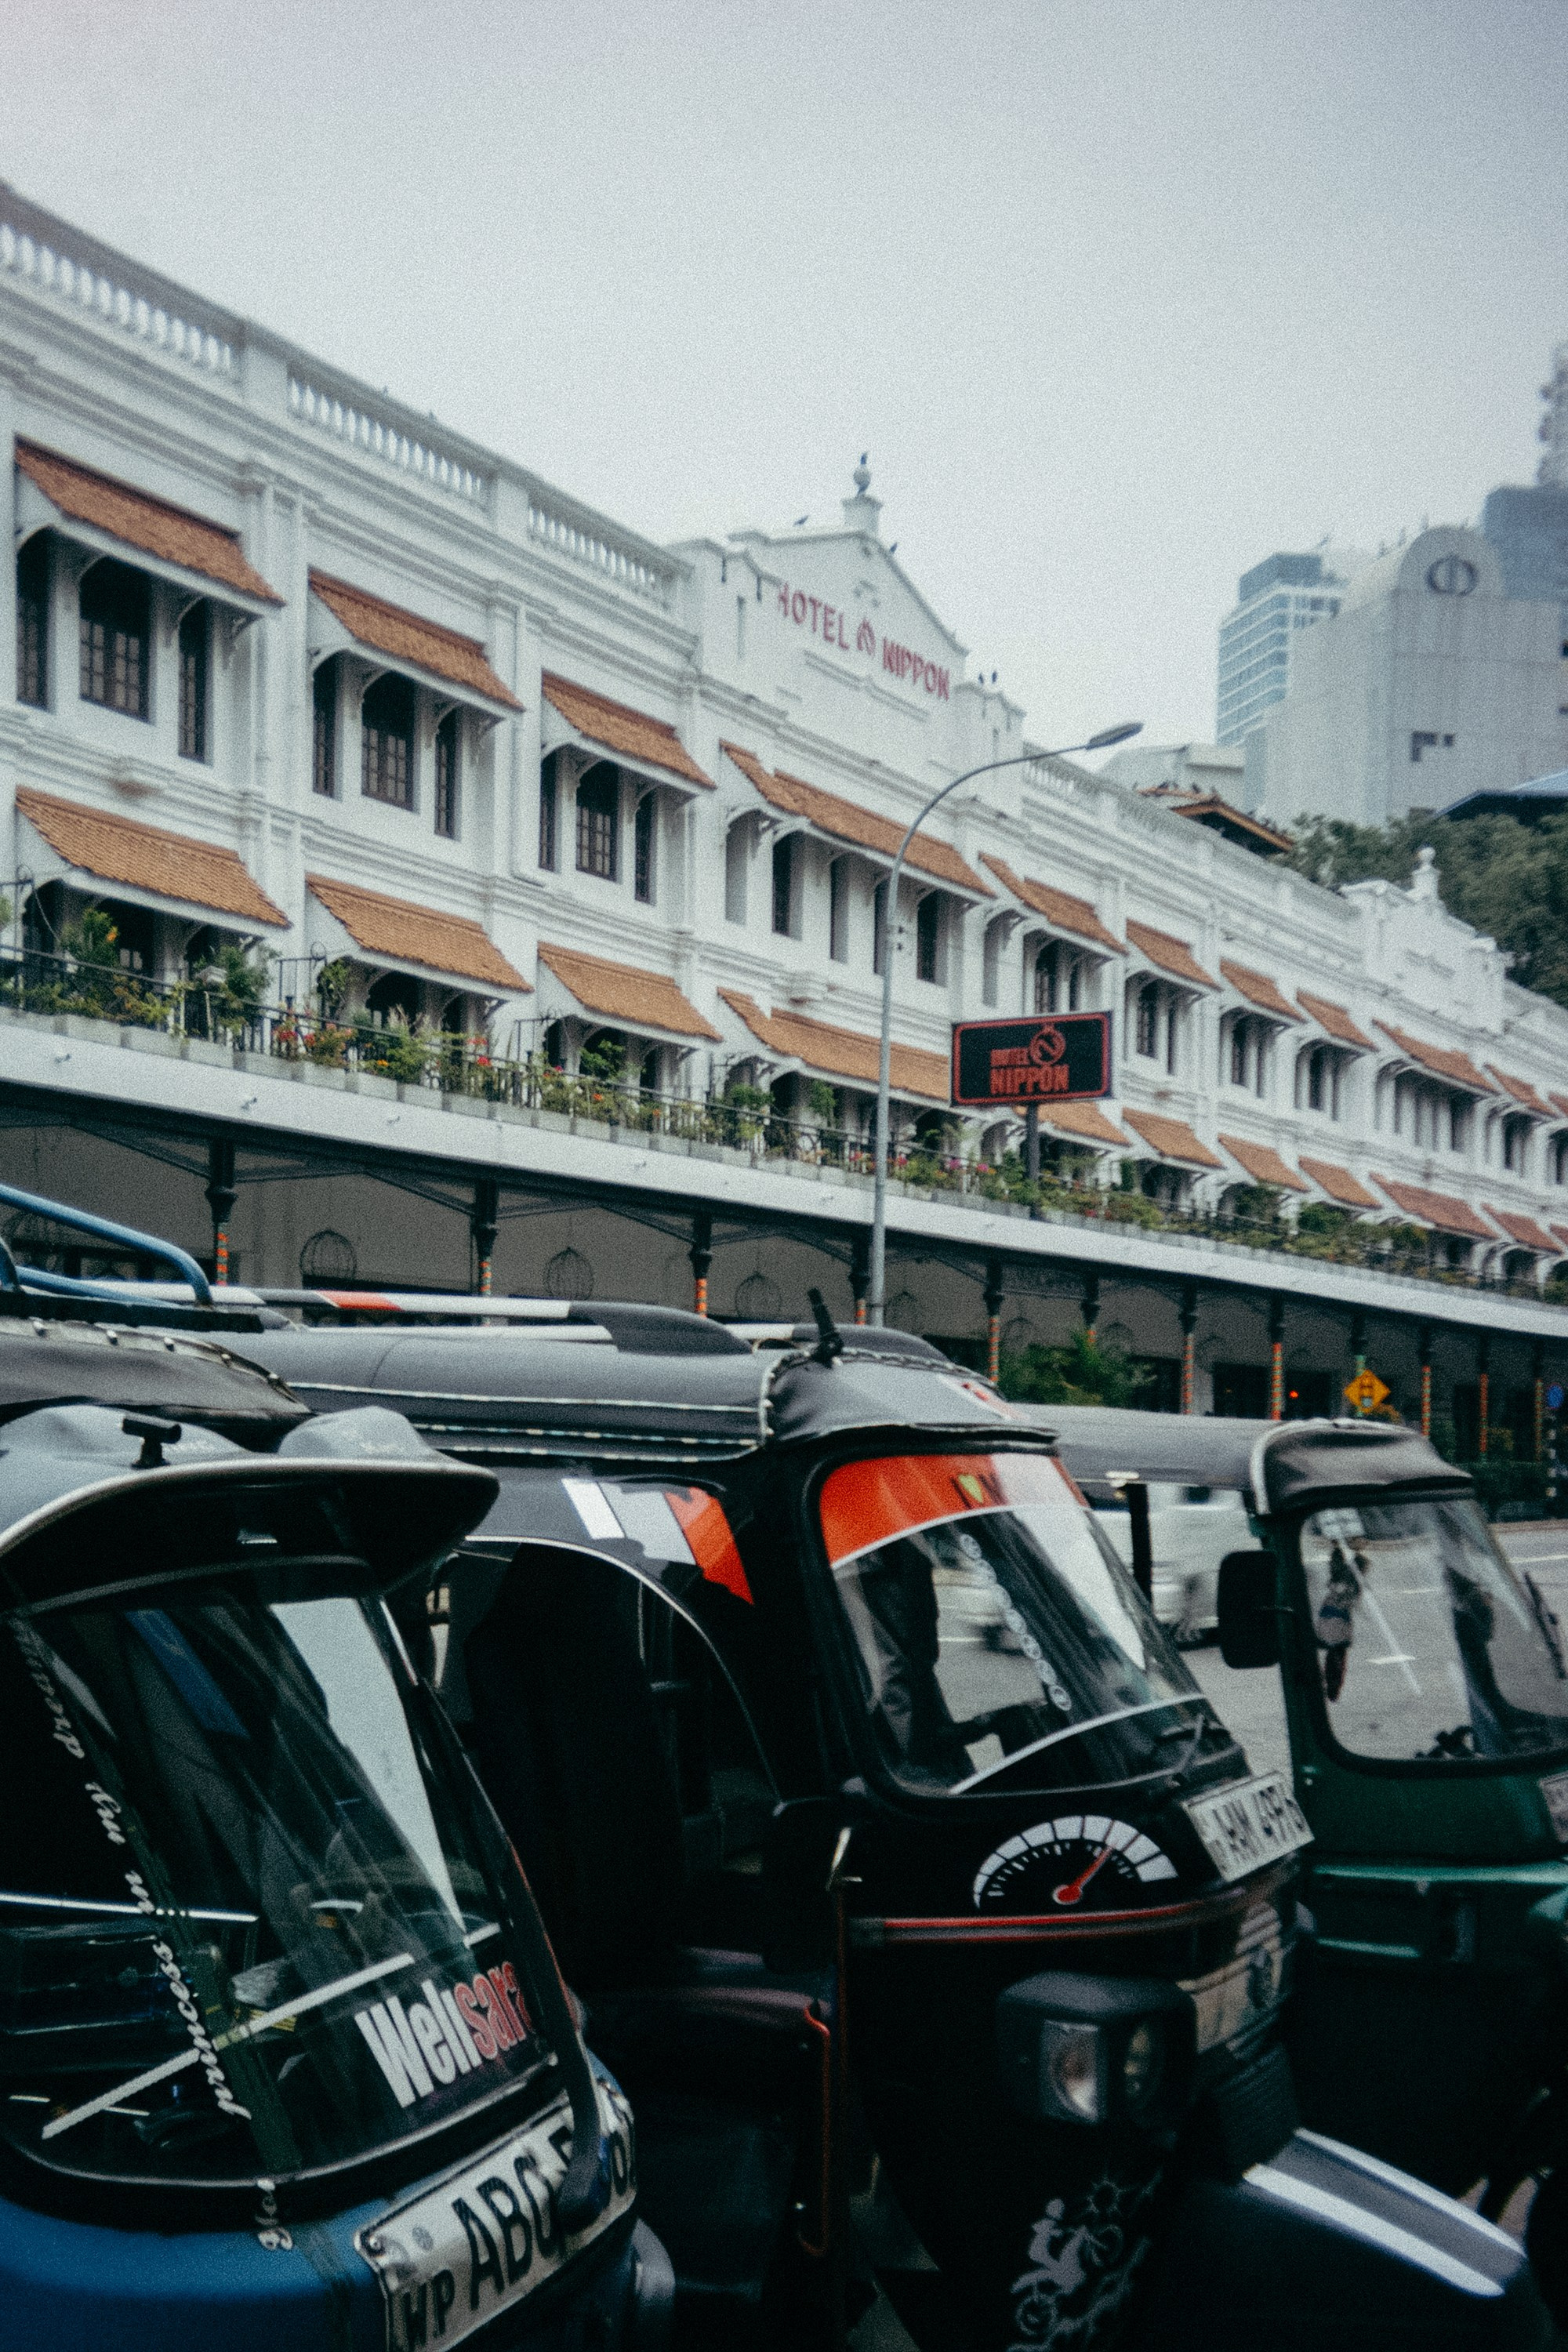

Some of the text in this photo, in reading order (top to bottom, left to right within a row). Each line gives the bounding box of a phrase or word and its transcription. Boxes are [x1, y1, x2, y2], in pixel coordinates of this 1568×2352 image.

[778, 583, 950, 702] HOTEL NIPPON
[989, 1064, 1069, 1094] NIPPON
[85, 1782, 125, 1844] my
[152, 1942, 252, 2119] princess
